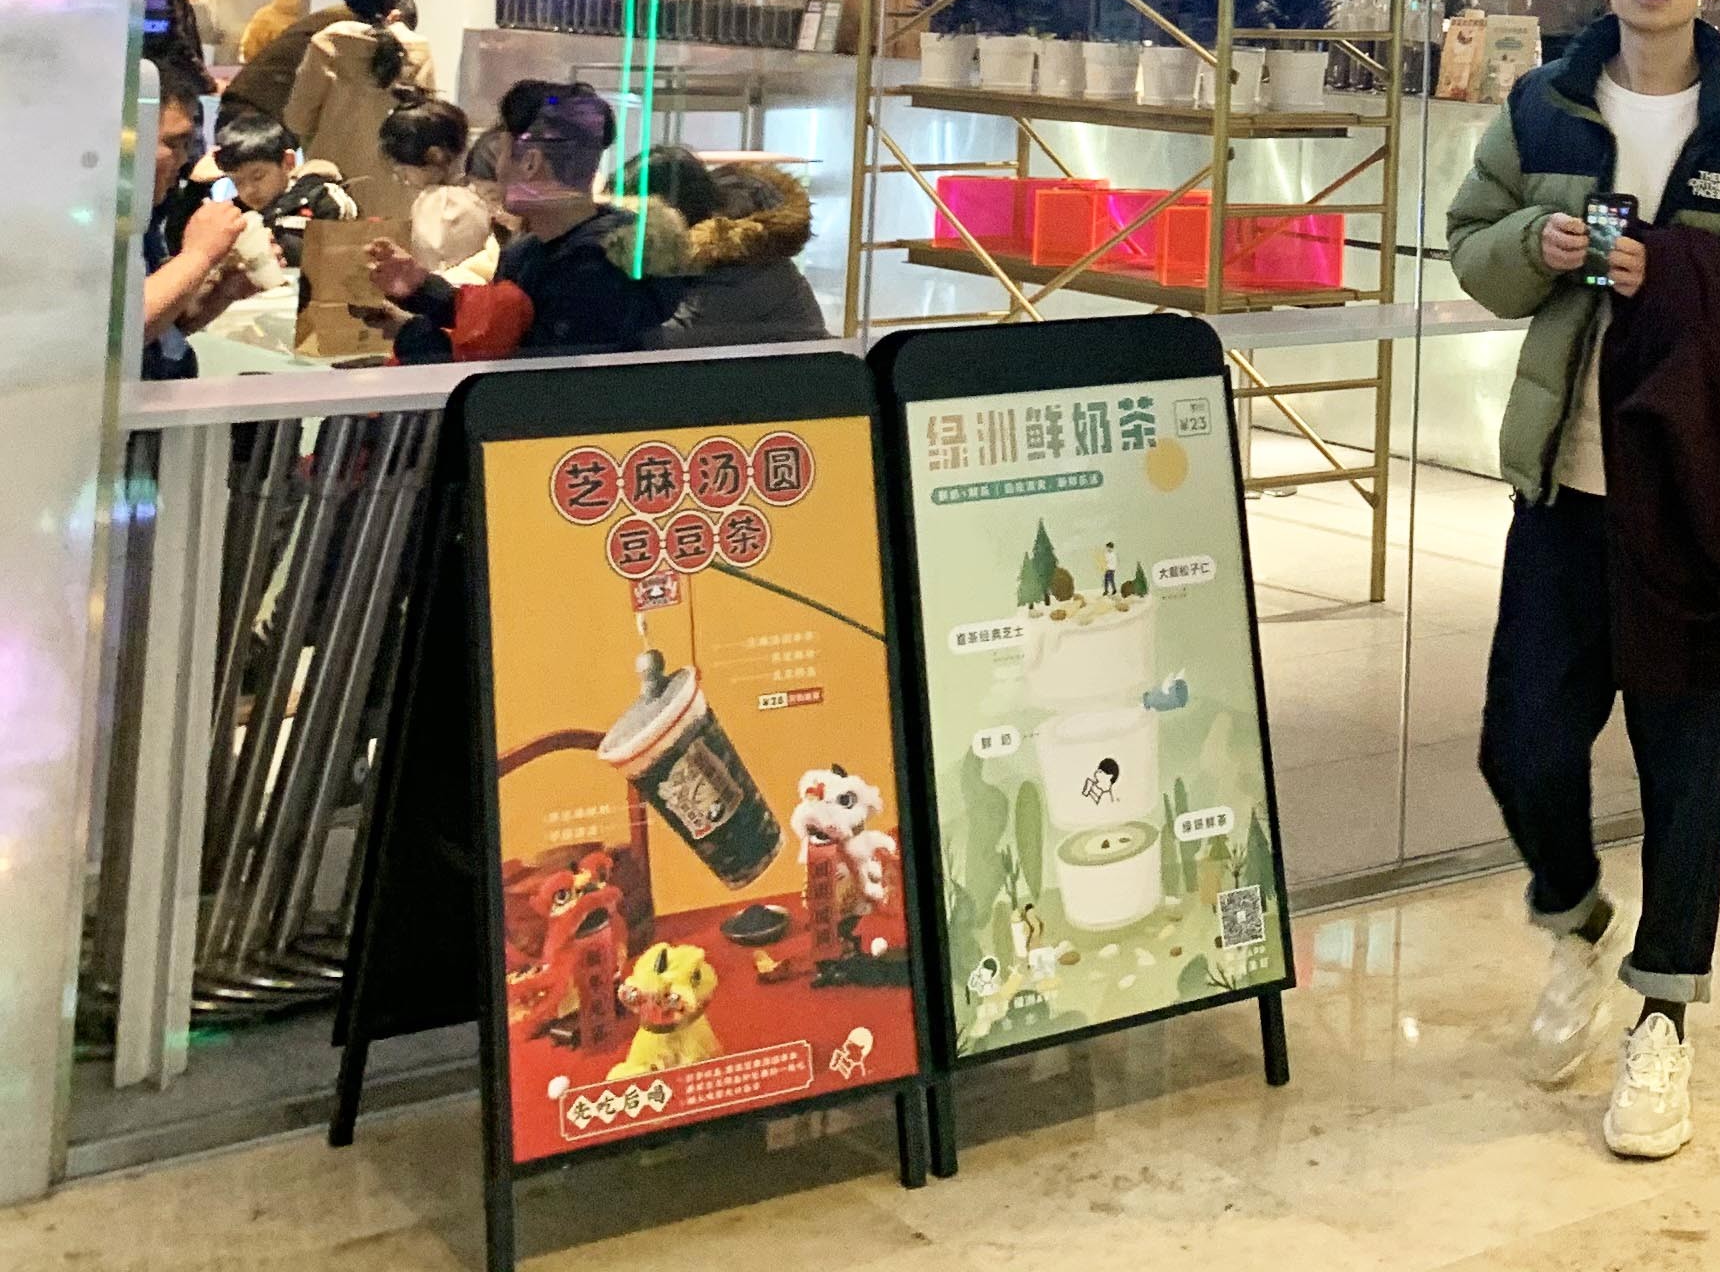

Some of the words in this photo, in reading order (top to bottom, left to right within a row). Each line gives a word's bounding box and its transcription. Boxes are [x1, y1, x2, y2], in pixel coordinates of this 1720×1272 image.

[563, 445, 801, 509] 芝麻汤圆
[617, 515, 763, 566] 豆豆茶
